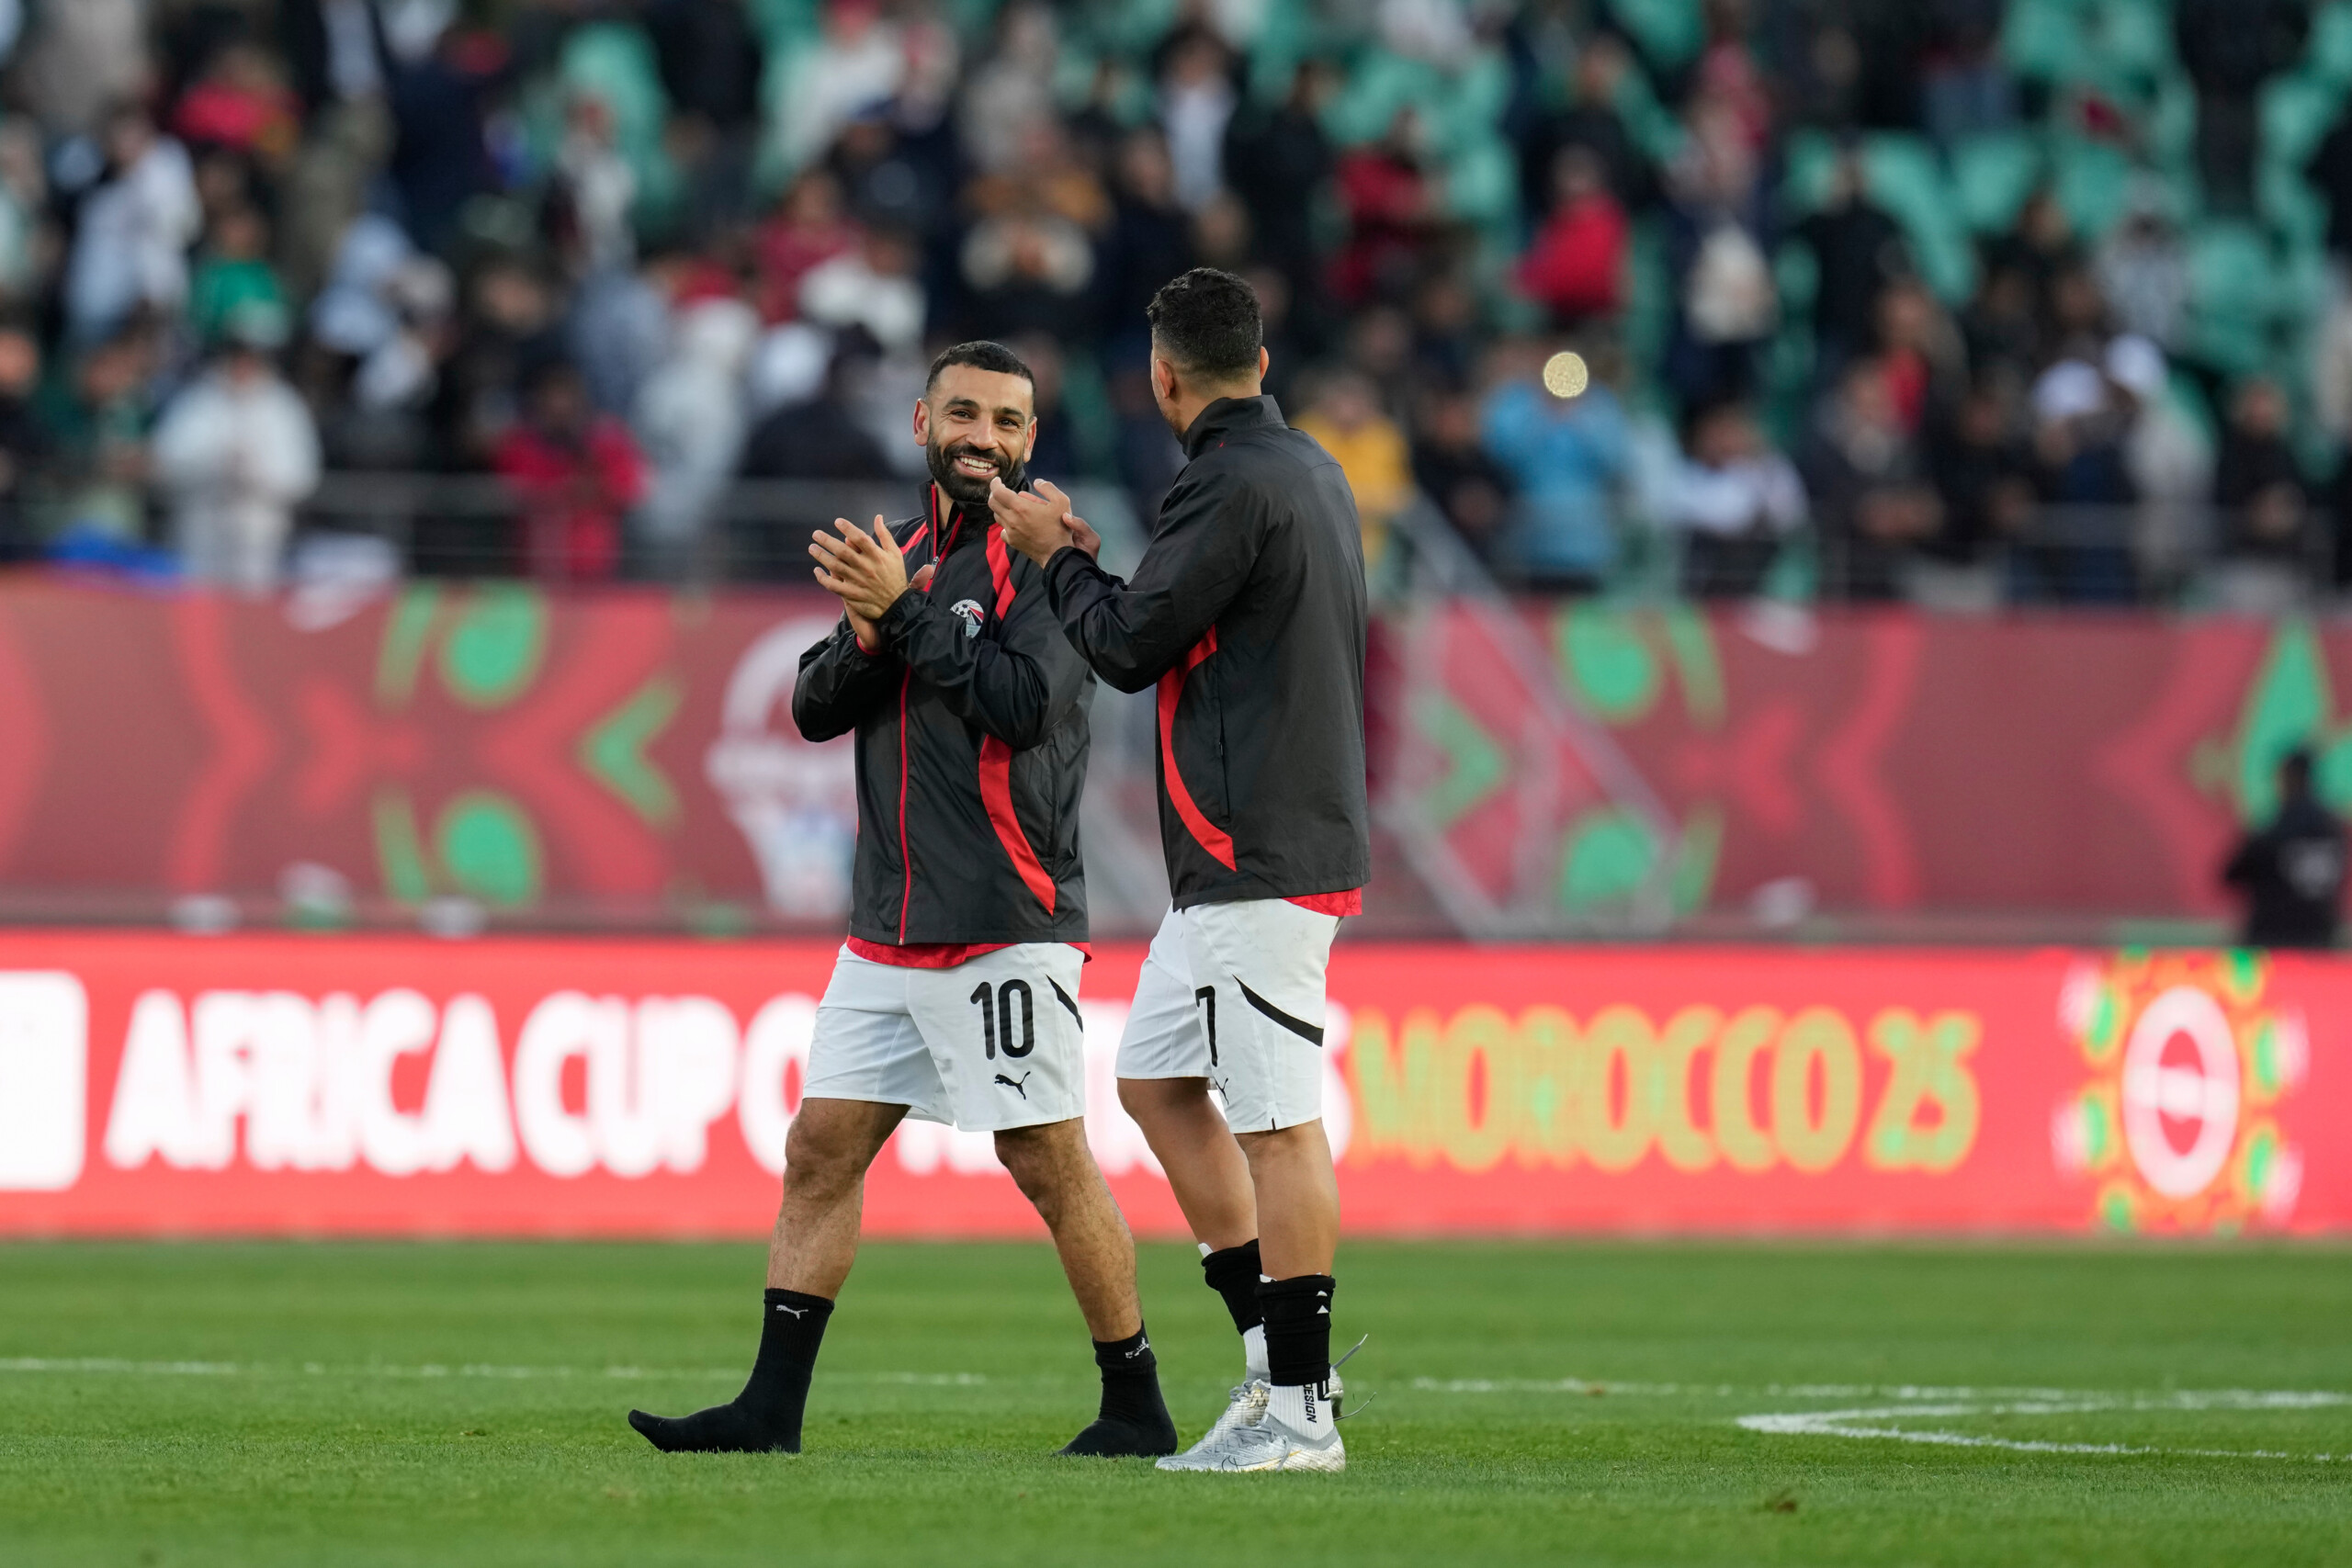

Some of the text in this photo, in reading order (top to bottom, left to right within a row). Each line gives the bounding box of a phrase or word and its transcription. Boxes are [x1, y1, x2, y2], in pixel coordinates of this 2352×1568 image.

[969, 978, 1034, 1060] 10
[1194, 985, 1218, 1067] 7
[104, 987, 517, 1177] AFRICA
[514, 991, 740, 1179] CUP
[1350, 1005, 1864, 1174] MOROCCO
[1865, 1010, 1983, 1172] 25
